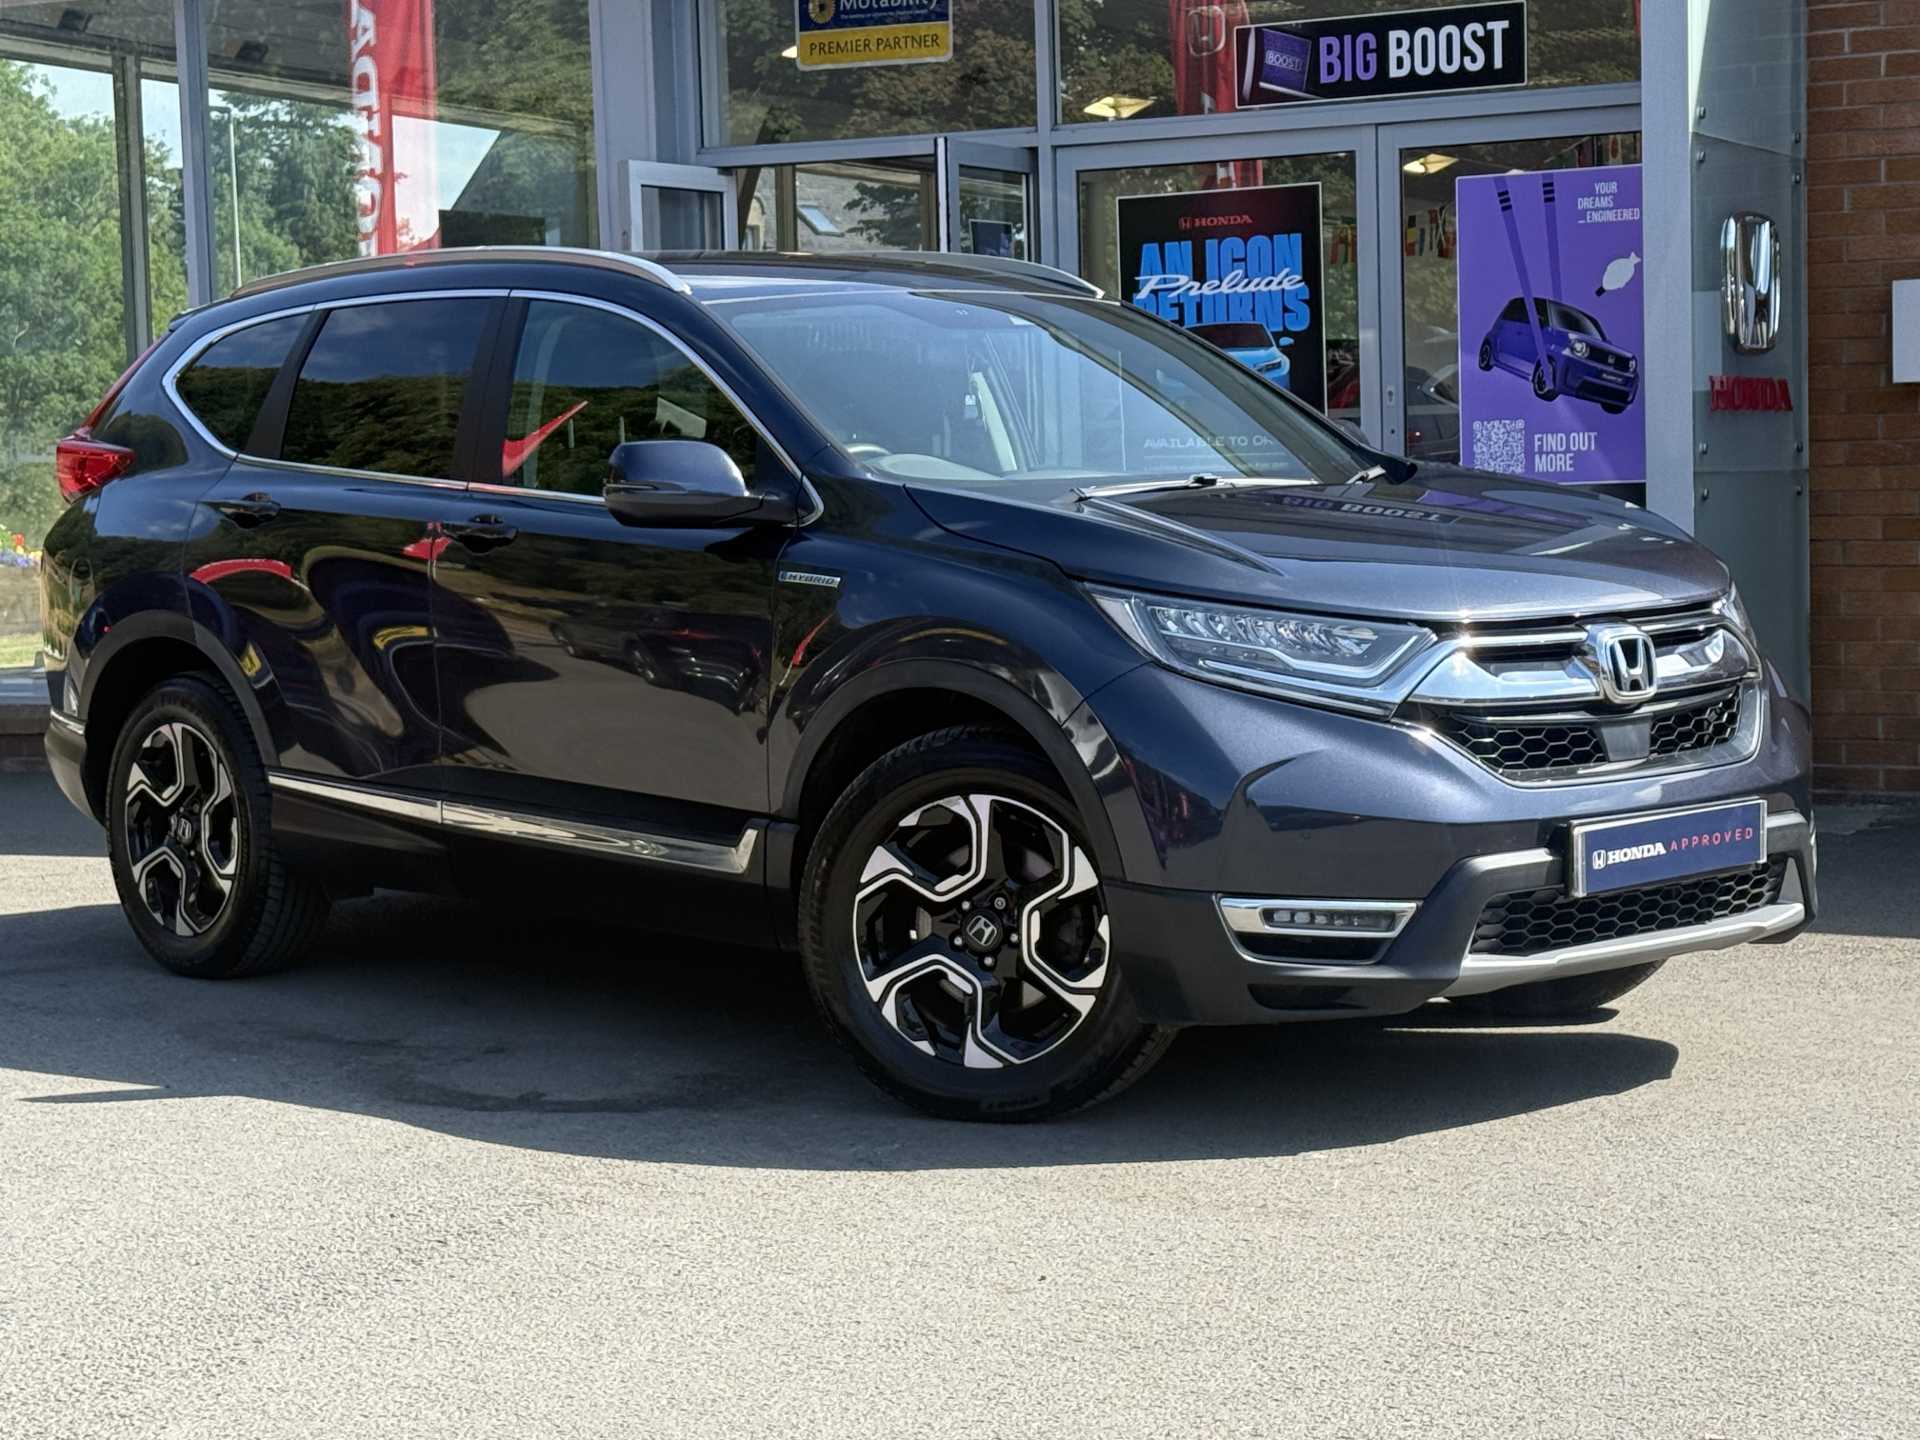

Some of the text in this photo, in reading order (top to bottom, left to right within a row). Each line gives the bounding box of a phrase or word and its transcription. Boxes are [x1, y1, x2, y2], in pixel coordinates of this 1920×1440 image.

[809, 34, 940, 56] PREMIER PARTNER
[1319, 20, 1509, 84] BIG BOOST
[1594, 181, 1618, 194] YOUR
[1577, 195, 1614, 210] DREAMS
[1194, 214, 1253, 227] HONDA
[1139, 233, 1303, 290] AN ICON
[1134, 267, 1306, 300] Prelude
[1534, 432, 1597, 452] FIND OUT
[1534, 453, 1575, 473] MORE
[788, 572, 836, 586] HYBRID
[1607, 827, 1753, 865] HONDA APPROVED
